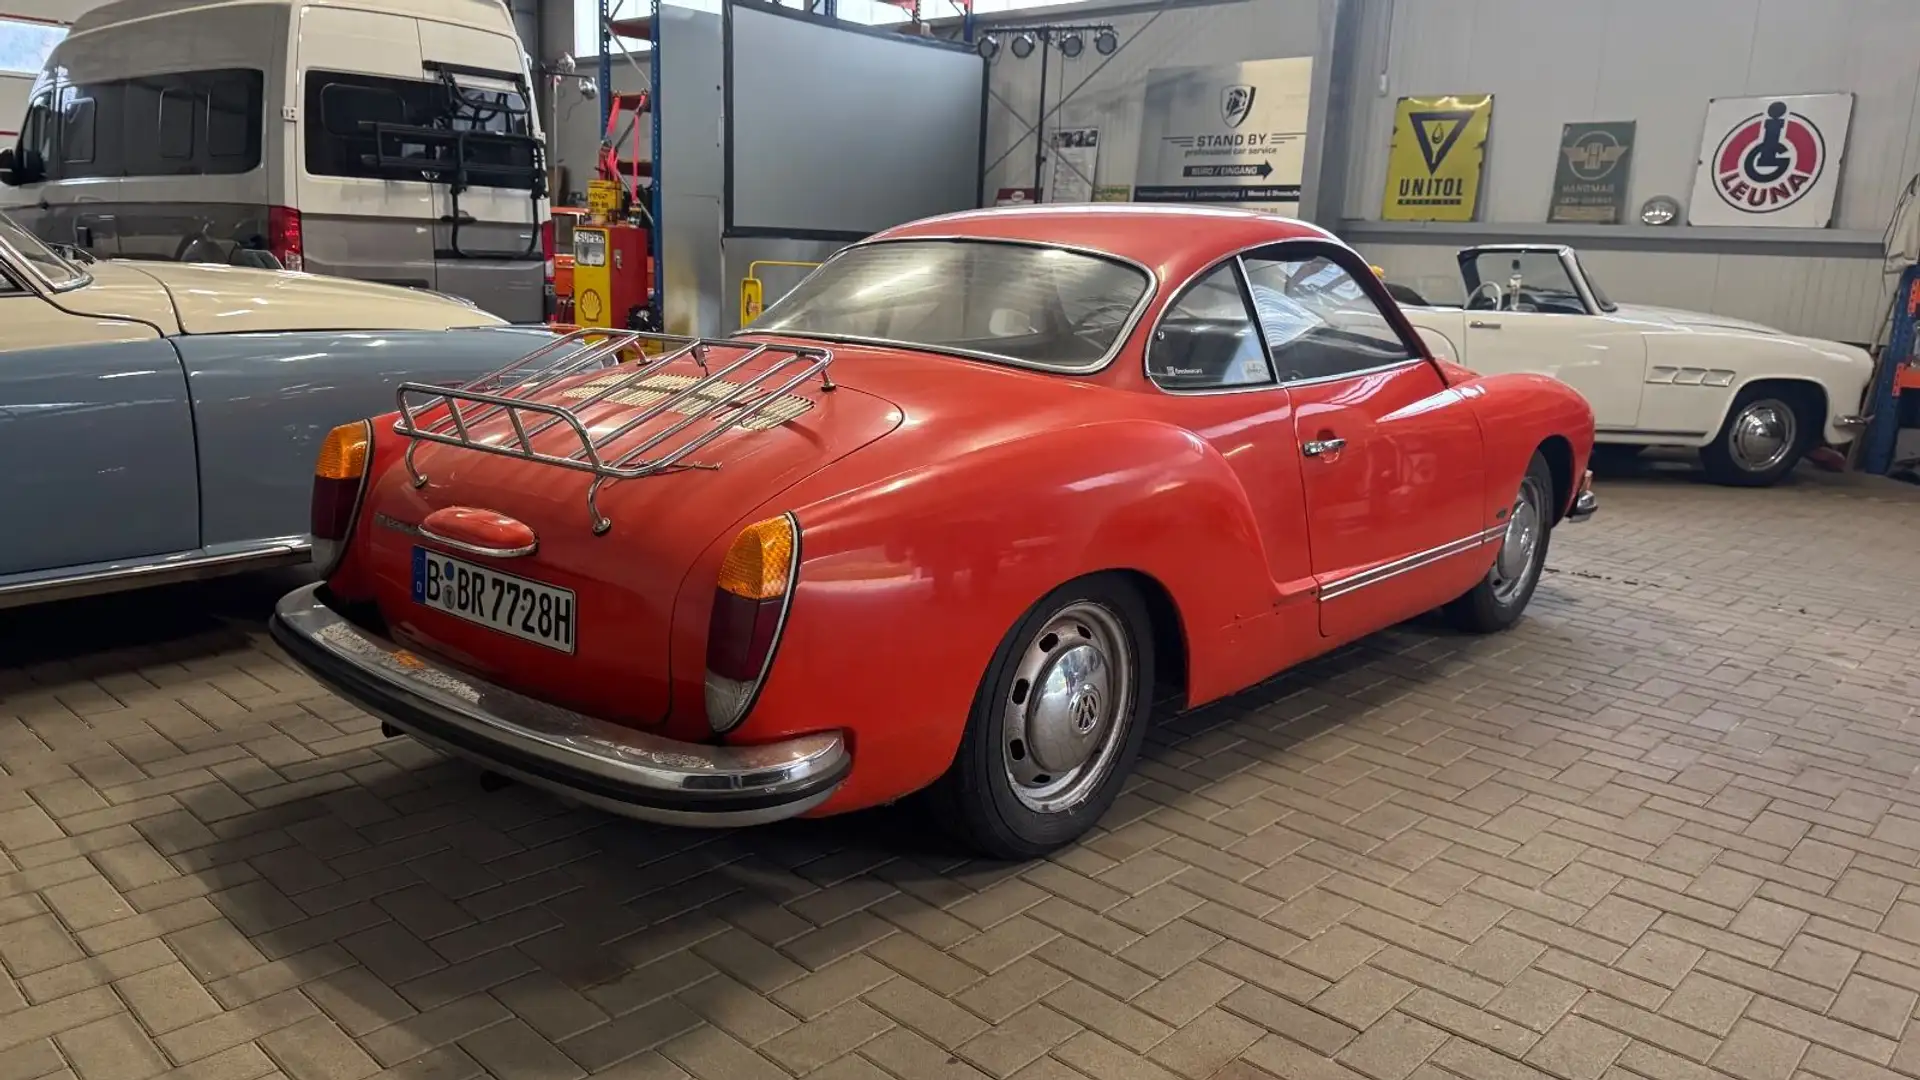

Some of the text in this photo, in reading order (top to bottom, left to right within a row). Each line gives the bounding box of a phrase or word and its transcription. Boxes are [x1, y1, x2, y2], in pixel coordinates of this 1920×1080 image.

[1197, 133, 1267, 147] STAND BY
[1248, 147, 1277, 155] service
[1221, 165, 1258, 176] EINGANG
[1399, 177, 1463, 197] UNITOL
[1720, 172, 1810, 207] LEUNA
[578, 231, 603, 243] SUPER
[426, 559, 571, 645] B BR 7728H
